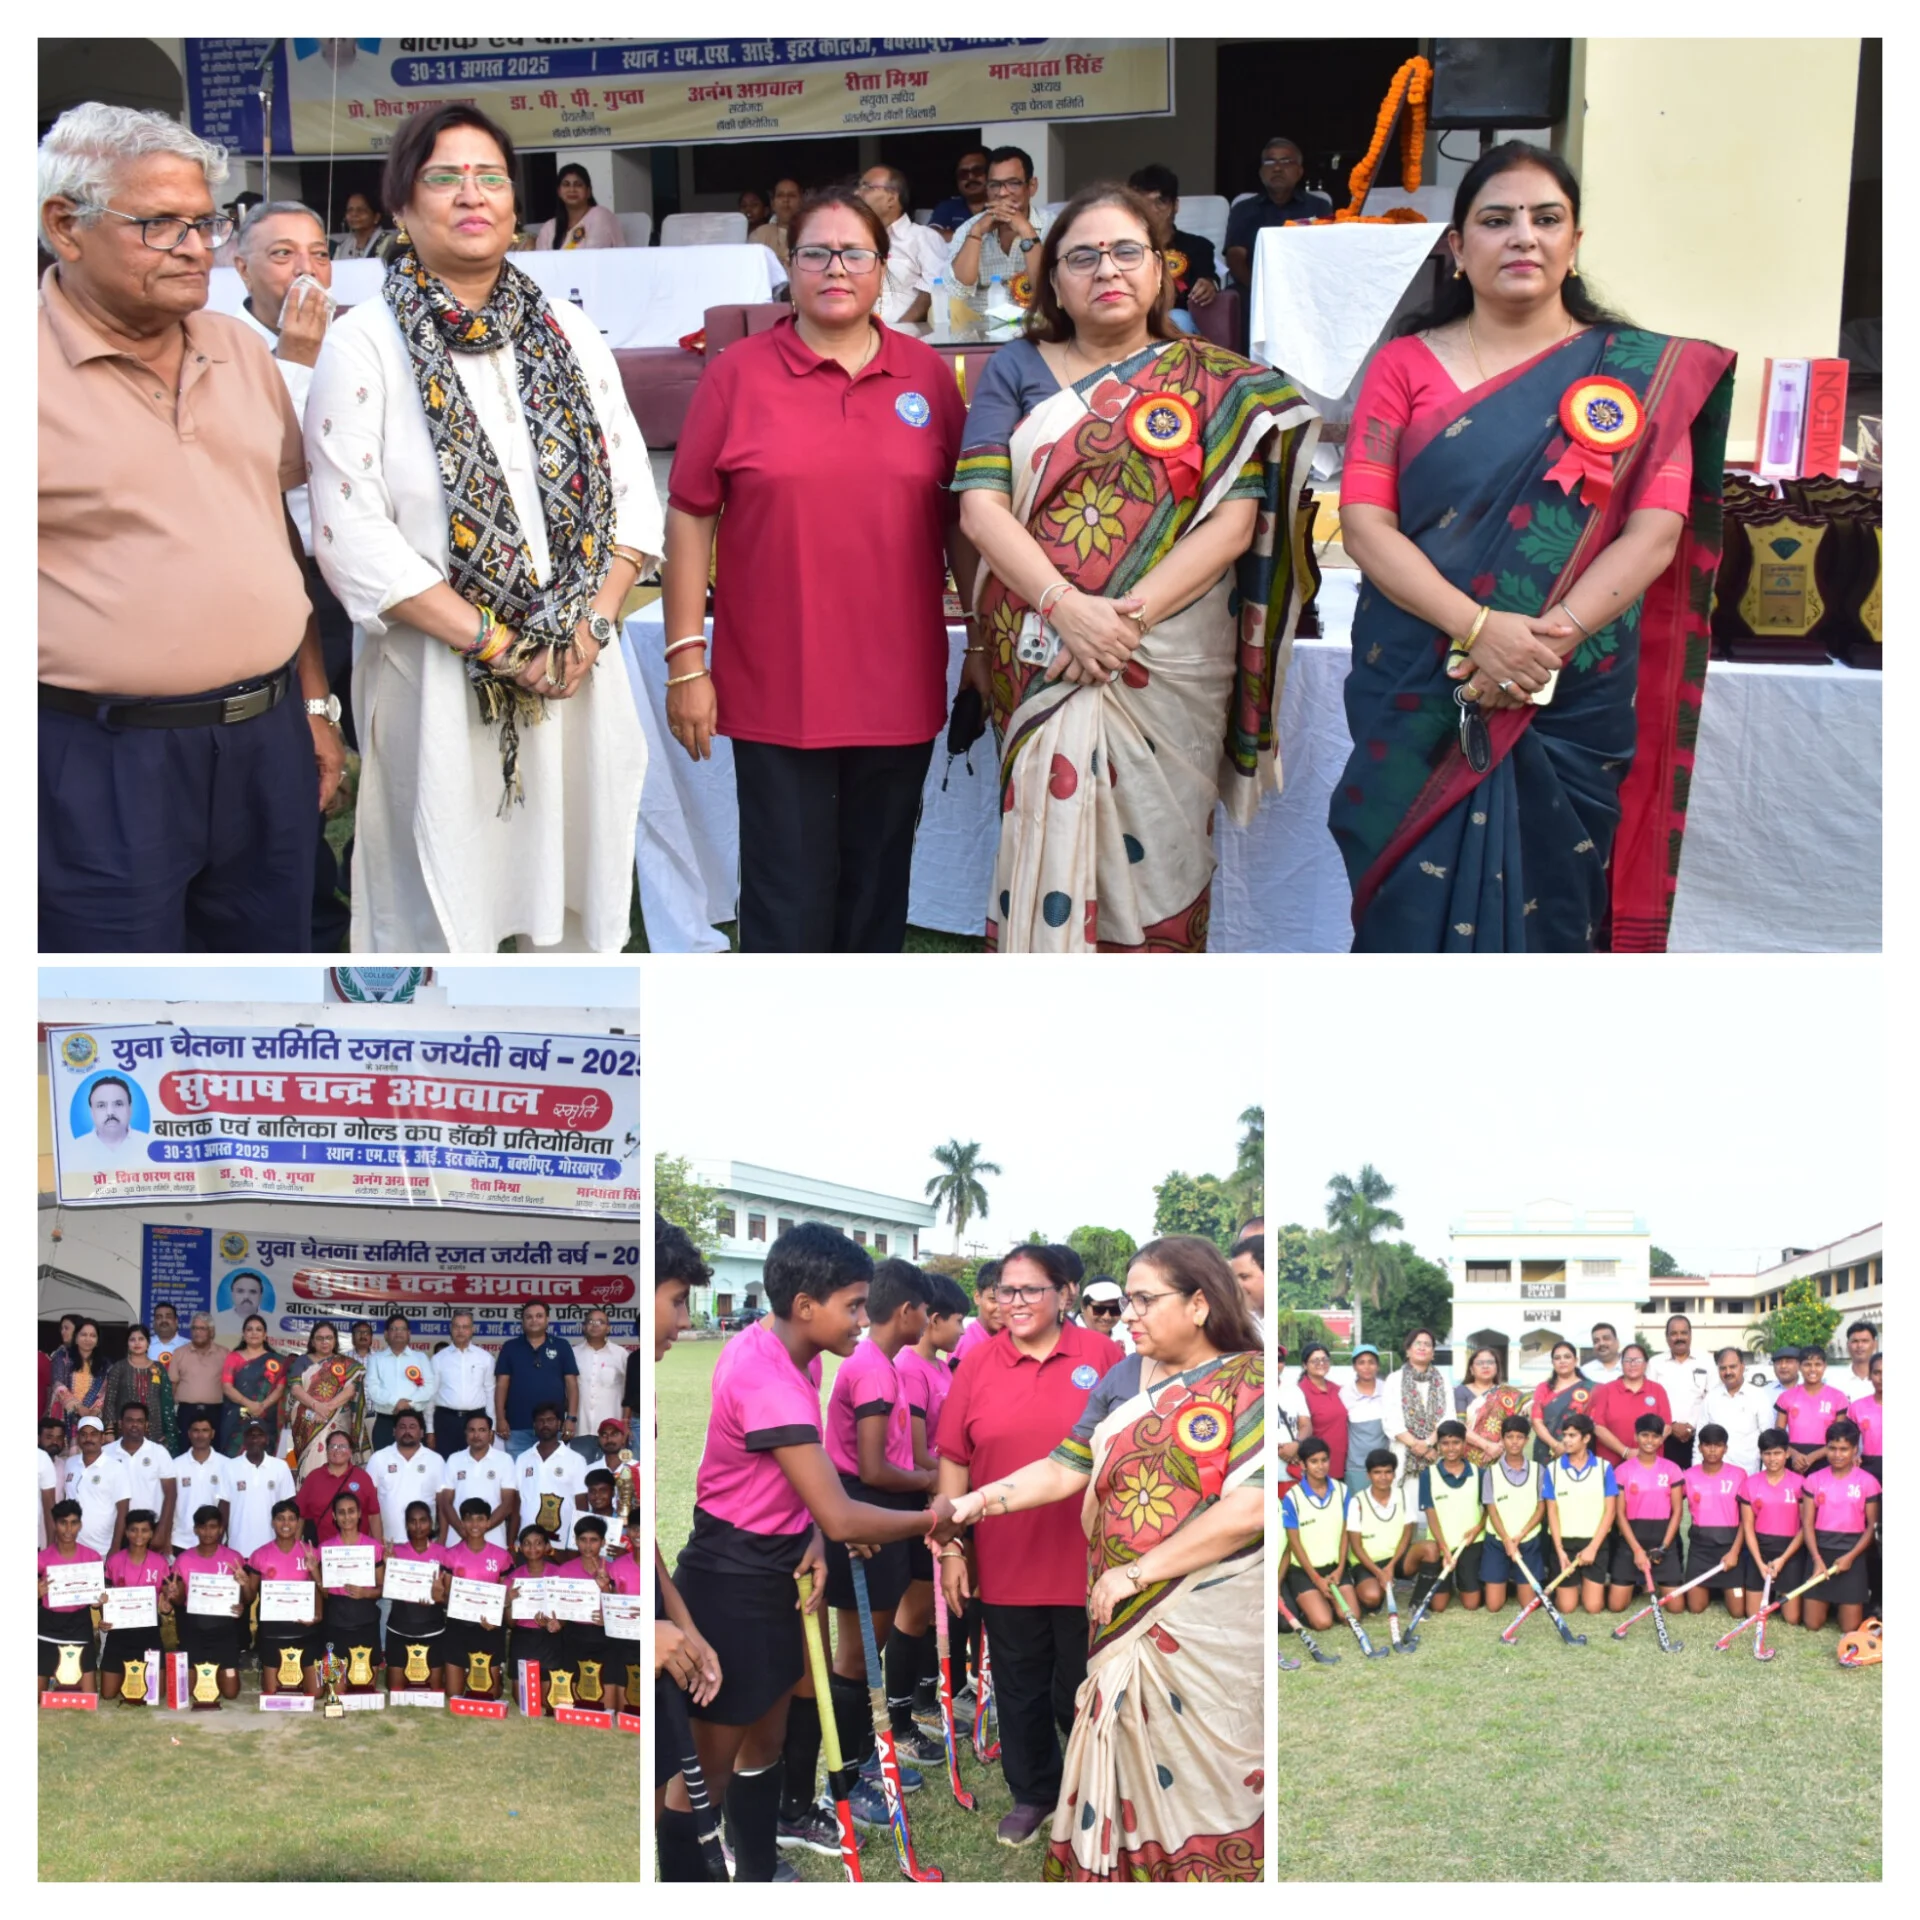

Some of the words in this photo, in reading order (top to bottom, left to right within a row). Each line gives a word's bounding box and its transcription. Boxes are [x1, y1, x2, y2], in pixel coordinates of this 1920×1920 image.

[409, 62, 456, 81] 30-31
[460, 59, 503, 78] अगस्त
[507, 56, 550, 76] 2025
[622, 49, 658, 69] स्थान
[988, 57, 1061, 80] मान्धाता
[1065, 53, 1105, 76] सिंह
[688, 81, 733, 102] अनंग
[737, 79, 804, 99] अग्रवाल
[844, 69, 881, 92] रीता
[885, 68, 930, 89] मिश्रा
[347, 100, 371, 118] प्रो.
[373, 97, 403, 117] शिव
[510, 94, 534, 111] डा.
[538, 89, 566, 109] पी.
[570, 87, 598, 108] पी.
[602, 87, 644, 111] गुप्ता
[1056, 94, 1085, 110] समिति
[1809, 370, 1844, 468] MILTON
[111, 1036, 164, 1072] युवा
[170, 1026, 246, 1059] चेतना
[252, 1027, 342, 1061] समिति
[348, 1038, 416, 1063] रजत
[420, 1034, 503, 1068] जयंती
[508, 1038, 552, 1072] वर्ष
[172, 1072, 289, 1112] सुभाष
[294, 1075, 378, 1107] चन्द्र
[387, 1077, 545, 1116] अग्रवाल
[552, 1094, 601, 1128] स्मृति
[153, 1117, 213, 1138] बालक
[220, 1116, 252, 1138] एवं
[257, 1115, 337, 1139] बालिका
[344, 1116, 398, 1142] गोल्ड
[405, 1124, 442, 1144] कप
[448, 1122, 497, 1148] हॉकी
[503, 1126, 615, 1156] प्रतियोगिता
[163, 1143, 202, 1160] 30-31
[204, 1142, 233, 1158] अगस्त
[235, 1143, 269, 1158] 2025
[326, 1147, 354, 1162] स्थान
[413, 1145, 441, 1166] आई.
[445, 1147, 464, 1167] इंटर
[464, 1151, 503, 1172] कॉलेज,
[507, 1154, 555, 1177] बक्शीपुर,
[558, 1156, 606, 1180] गोरखपुर
[115, 1169, 140, 1184] शिव
[142, 1170, 171, 1183] शरण
[174, 1171, 196, 1183] दास
[220, 1167, 236, 1179] डा.
[240, 1166, 258, 1180] पी.
[262, 1168, 281, 1182] पी.
[286, 1171, 316, 1185] गुप्ता
[353, 1173, 383, 1186] अनंग
[470, 1177, 491, 1192] रीता
[493, 1179, 521, 1194] मिश्रा
[256, 1240, 296, 1267] युवा
[301, 1236, 359, 1261] चेतना
[363, 1240, 430, 1264] समिति
[435, 1246, 487, 1265] रजत
[491, 1241, 553, 1265] जयंती
[557, 1241, 590, 1266] वर्ष
[400, 1273, 457, 1295] चन्द्र
[465, 1275, 583, 1298] अग्रवाल
[591, 1278, 626, 1303] स्मृति
[478, 1307, 509, 1319] कप
[1657, 1473, 1669, 1488] 22
[1720, 1479, 1734, 1494] 17
[1847, 1484, 1861, 1499] 36
[145, 1568, 158, 1583] 14
[486, 1559, 498, 1572] 35
[874, 1733, 902, 1819] ALFA
